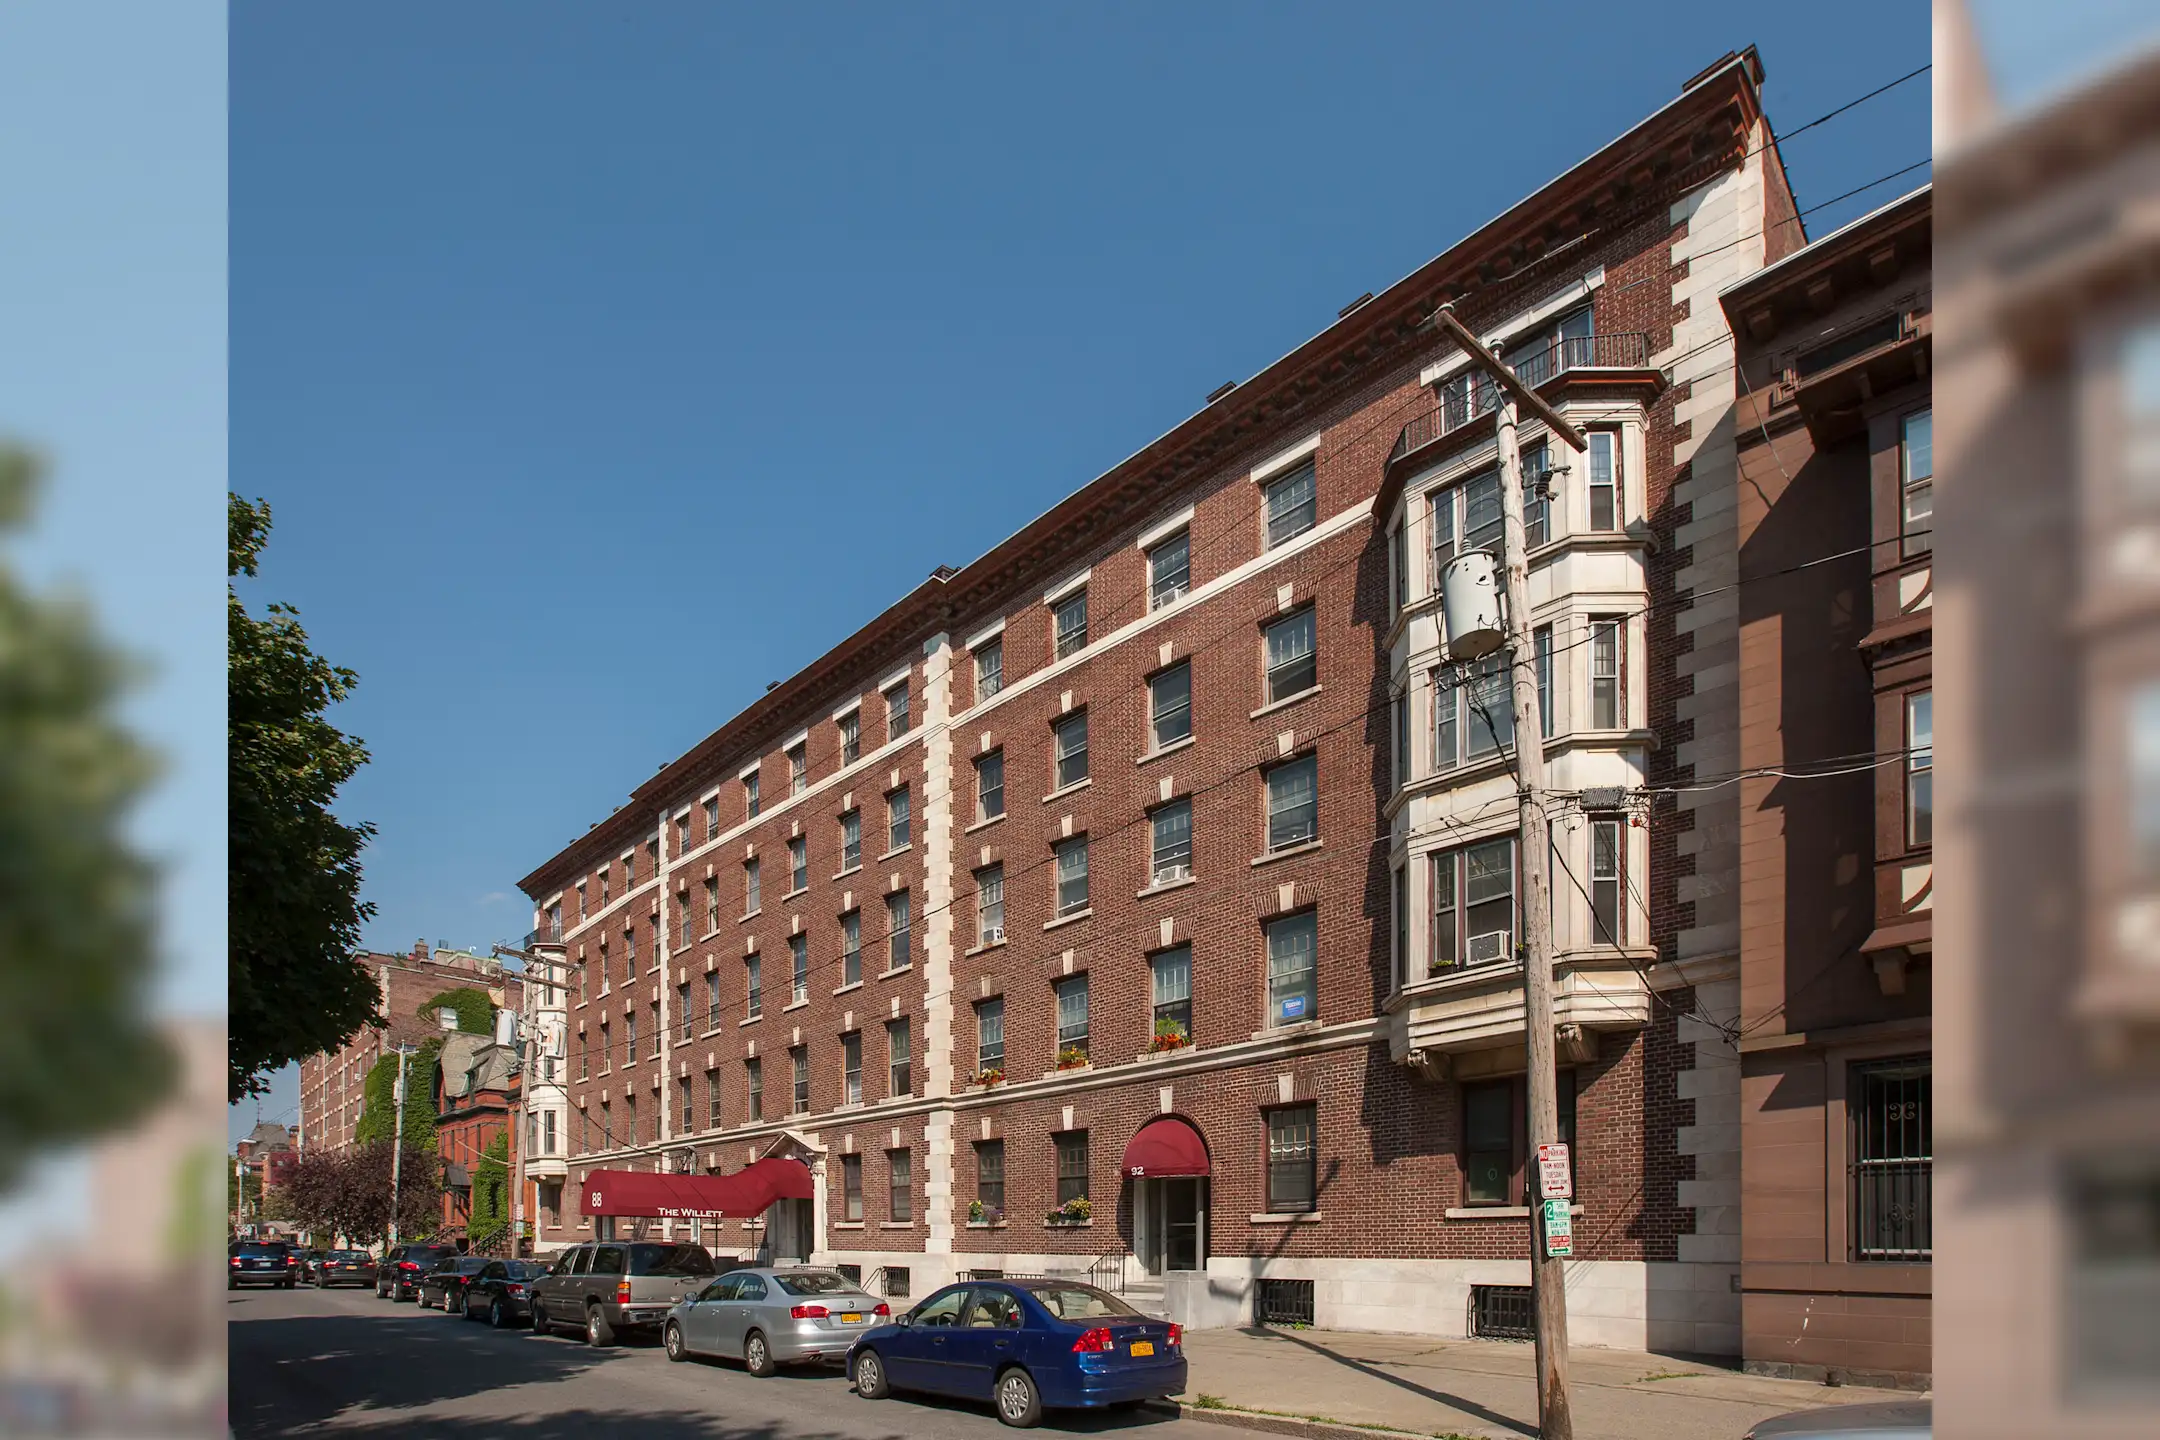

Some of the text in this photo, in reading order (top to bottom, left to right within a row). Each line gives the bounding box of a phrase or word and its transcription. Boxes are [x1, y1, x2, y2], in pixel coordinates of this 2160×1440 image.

[1548, 1149, 1566, 1157] PARKING
[1131, 1166, 1145, 1176] 92
[592, 1192, 602, 1207] 88
[658, 1207, 723, 1217] THE WILLETT
[1546, 1204, 1553, 1218] 2
